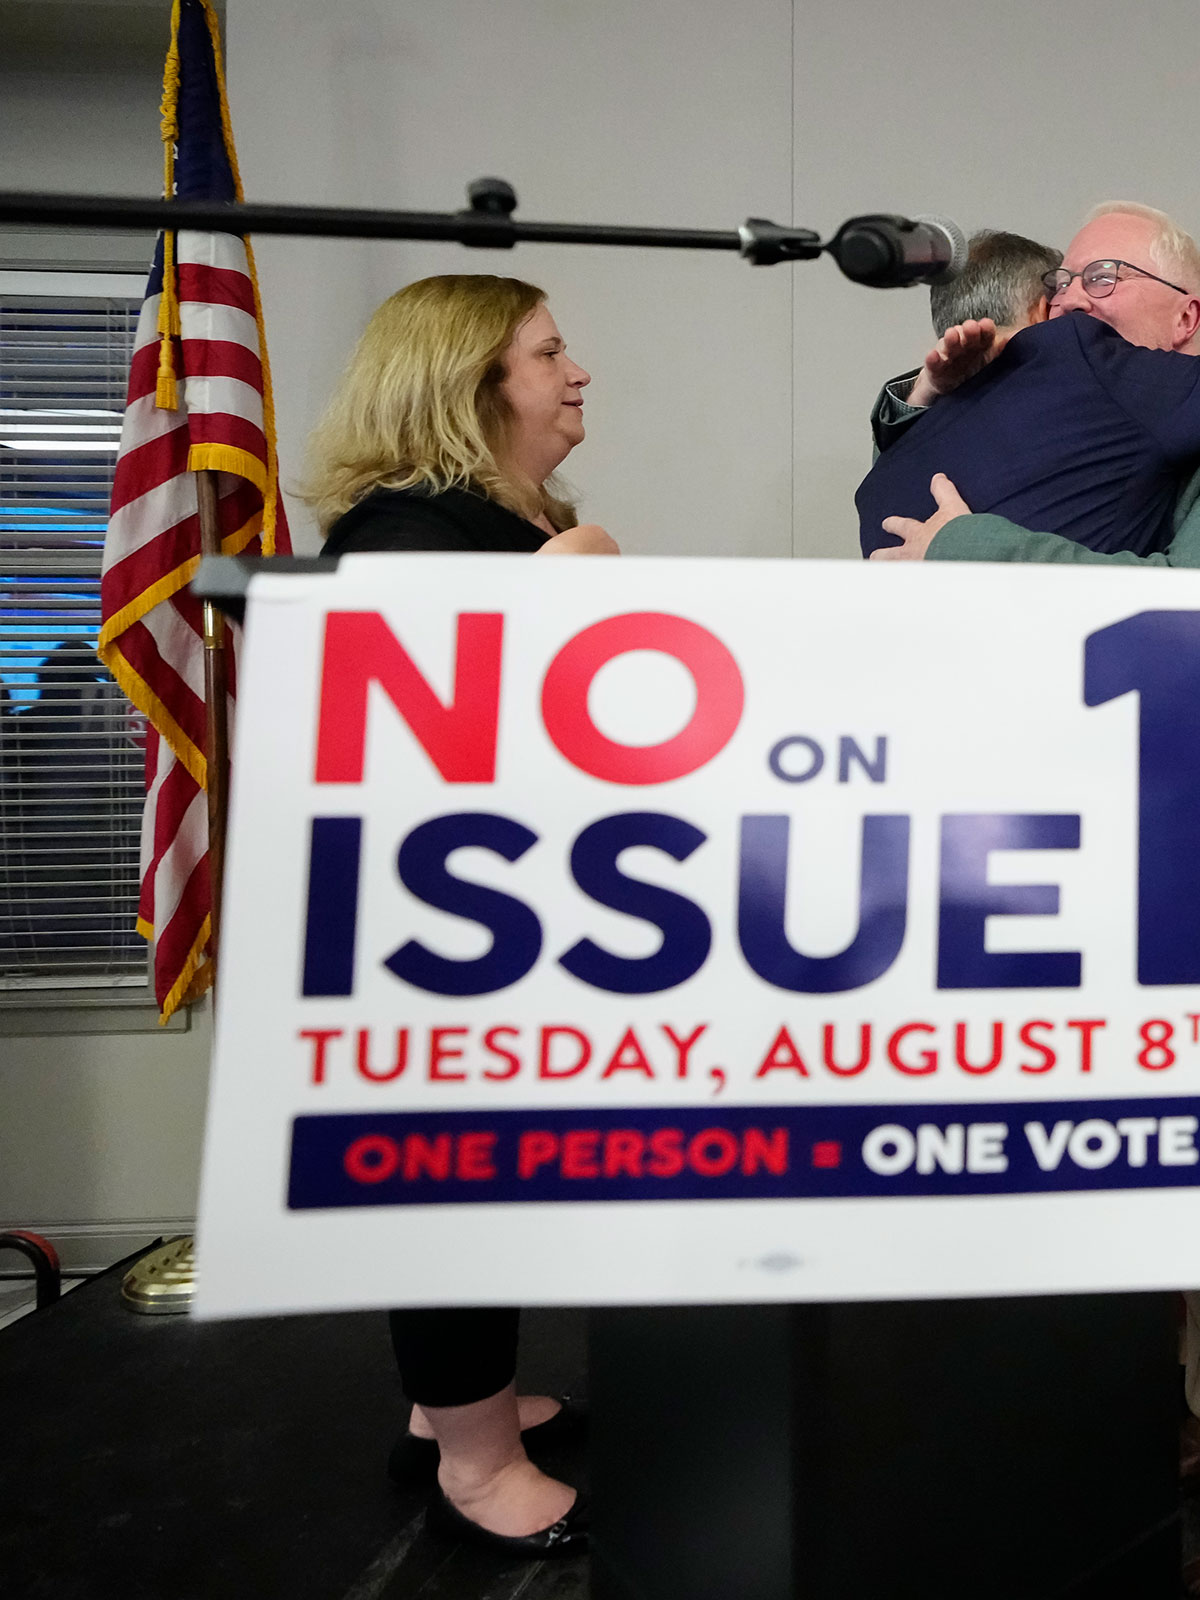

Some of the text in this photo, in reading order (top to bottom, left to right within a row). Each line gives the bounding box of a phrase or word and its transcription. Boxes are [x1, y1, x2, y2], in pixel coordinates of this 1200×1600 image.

[313, 609, 887, 786] NO ON
[299, 811, 1083, 998] ISSUE
[299, 1024, 726, 1093] TUESDAY,
[757, 1020, 1107, 1079] AUGUST
[344, 1117, 1200, 1184] ONE PERSON = ONE VOTE
